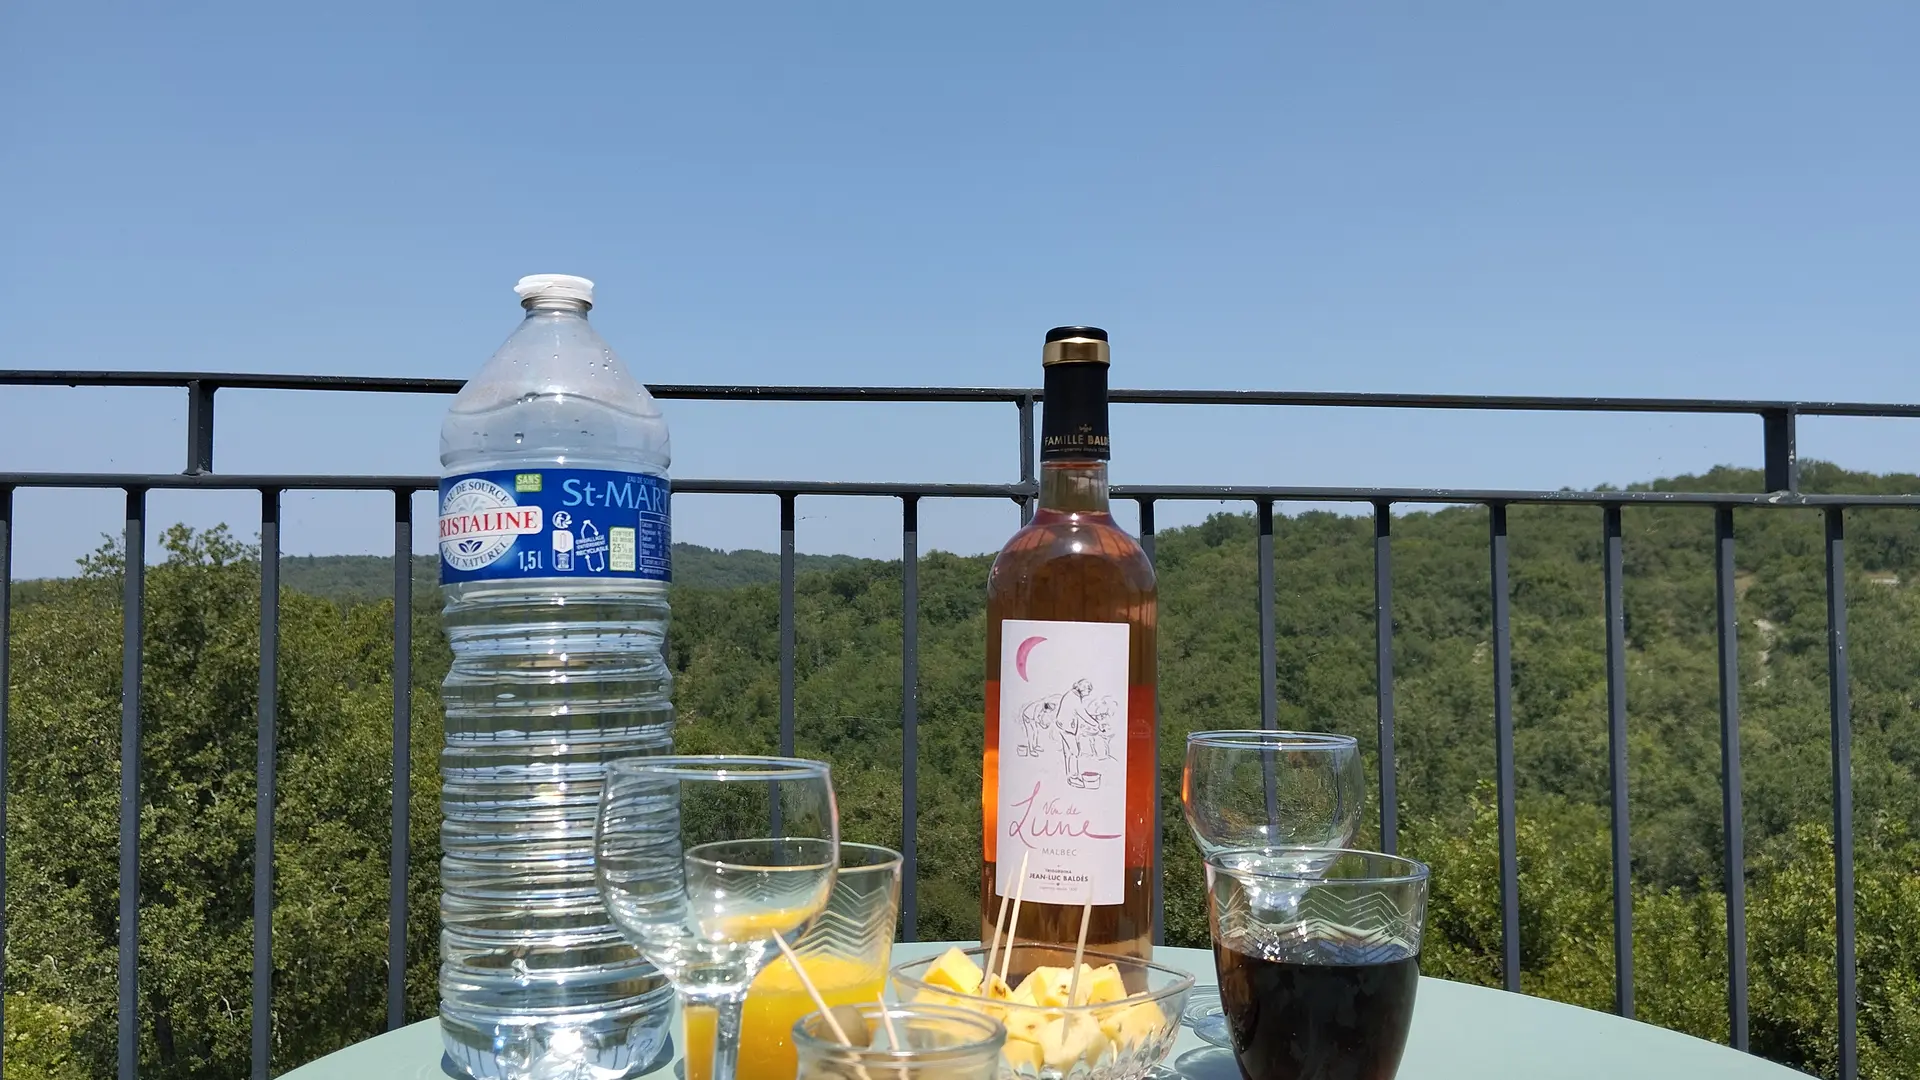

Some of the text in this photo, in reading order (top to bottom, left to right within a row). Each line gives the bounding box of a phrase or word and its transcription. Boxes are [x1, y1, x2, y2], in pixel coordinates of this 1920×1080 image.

[1044, 434, 1110, 446] FAMILLE BALD
[516, 474, 541, 485] SANS
[456, 484, 467, 495] DE
[468, 481, 510, 505] SOURCE
[462, 541, 507, 567] NATUREL
[1043, 797, 1081, 816] Vin de
[1009, 780, 1122, 849] Lune
[1042, 847, 1077, 857] MALBEC
[1029, 873, 1061, 882] JEAN-LUC
